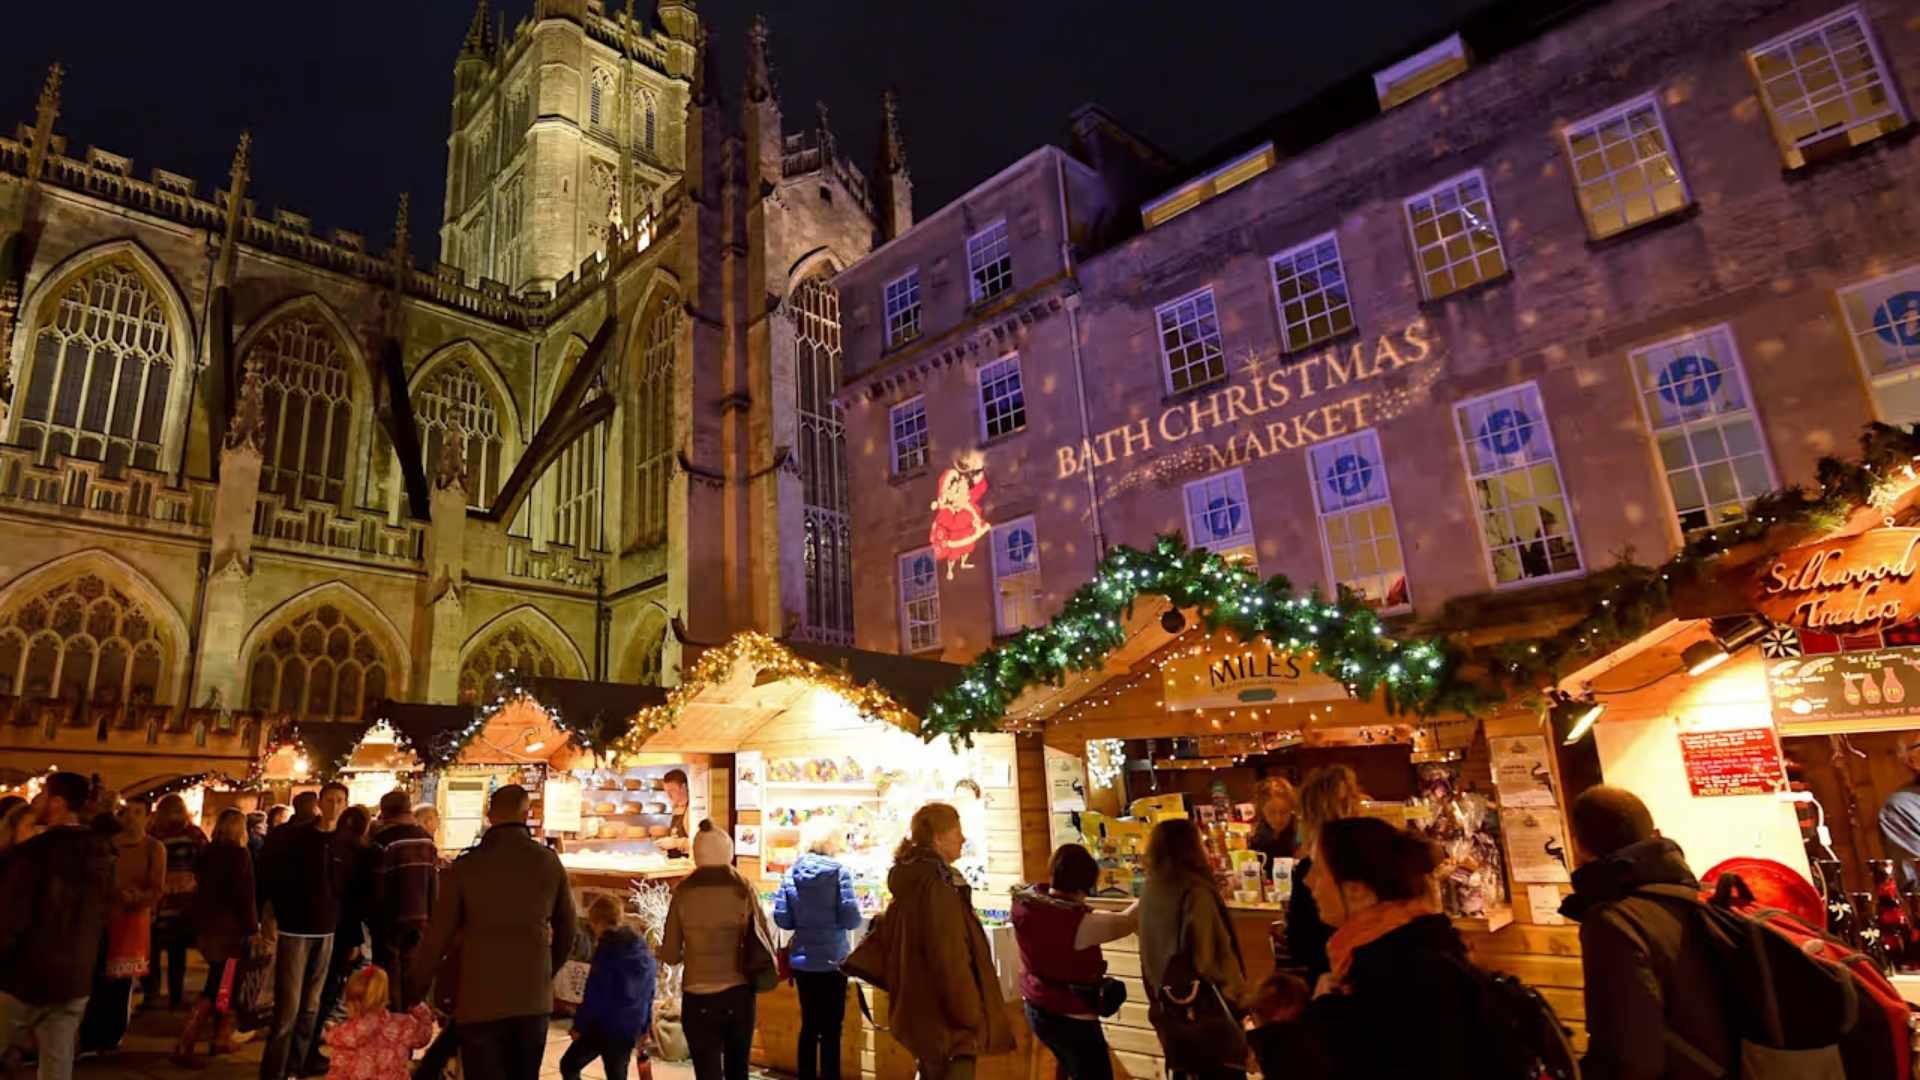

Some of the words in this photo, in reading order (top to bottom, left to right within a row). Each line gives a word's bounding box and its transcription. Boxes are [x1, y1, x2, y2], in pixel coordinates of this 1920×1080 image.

[1057, 418, 1153, 479] BATH
[1159, 319, 1430, 441] CHRISTMAS
[1205, 394, 1372, 472] MARKET
[1766, 535, 1920, 593] Silkwood
[1796, 581, 1901, 627] Traders
[1209, 654, 1301, 687] MILES
